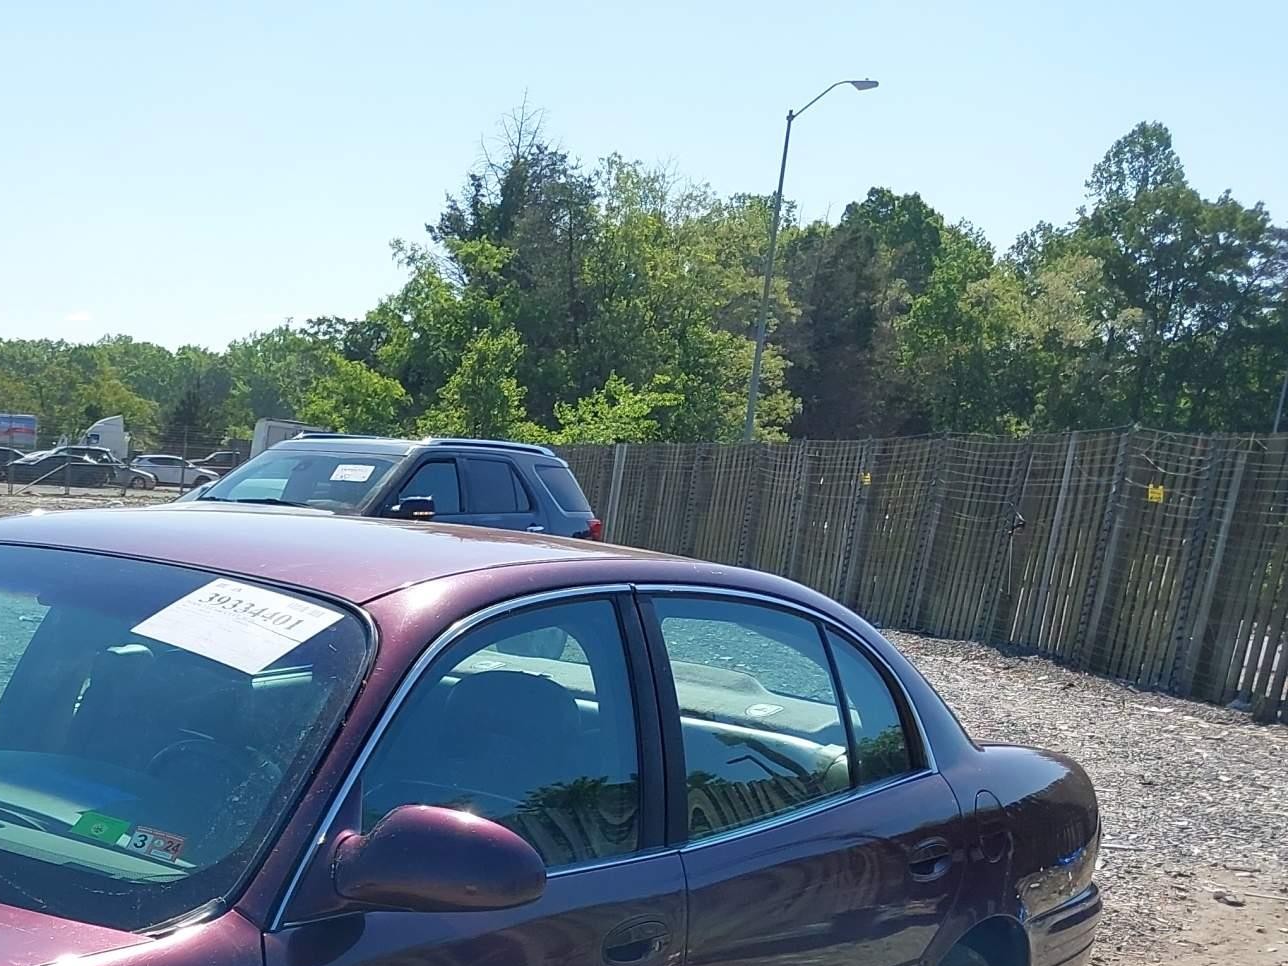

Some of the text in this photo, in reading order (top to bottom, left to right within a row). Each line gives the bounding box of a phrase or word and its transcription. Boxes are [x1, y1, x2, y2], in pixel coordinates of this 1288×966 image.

[197, 592, 305, 631] 39334401
[133, 834, 181, 855] 3 24
